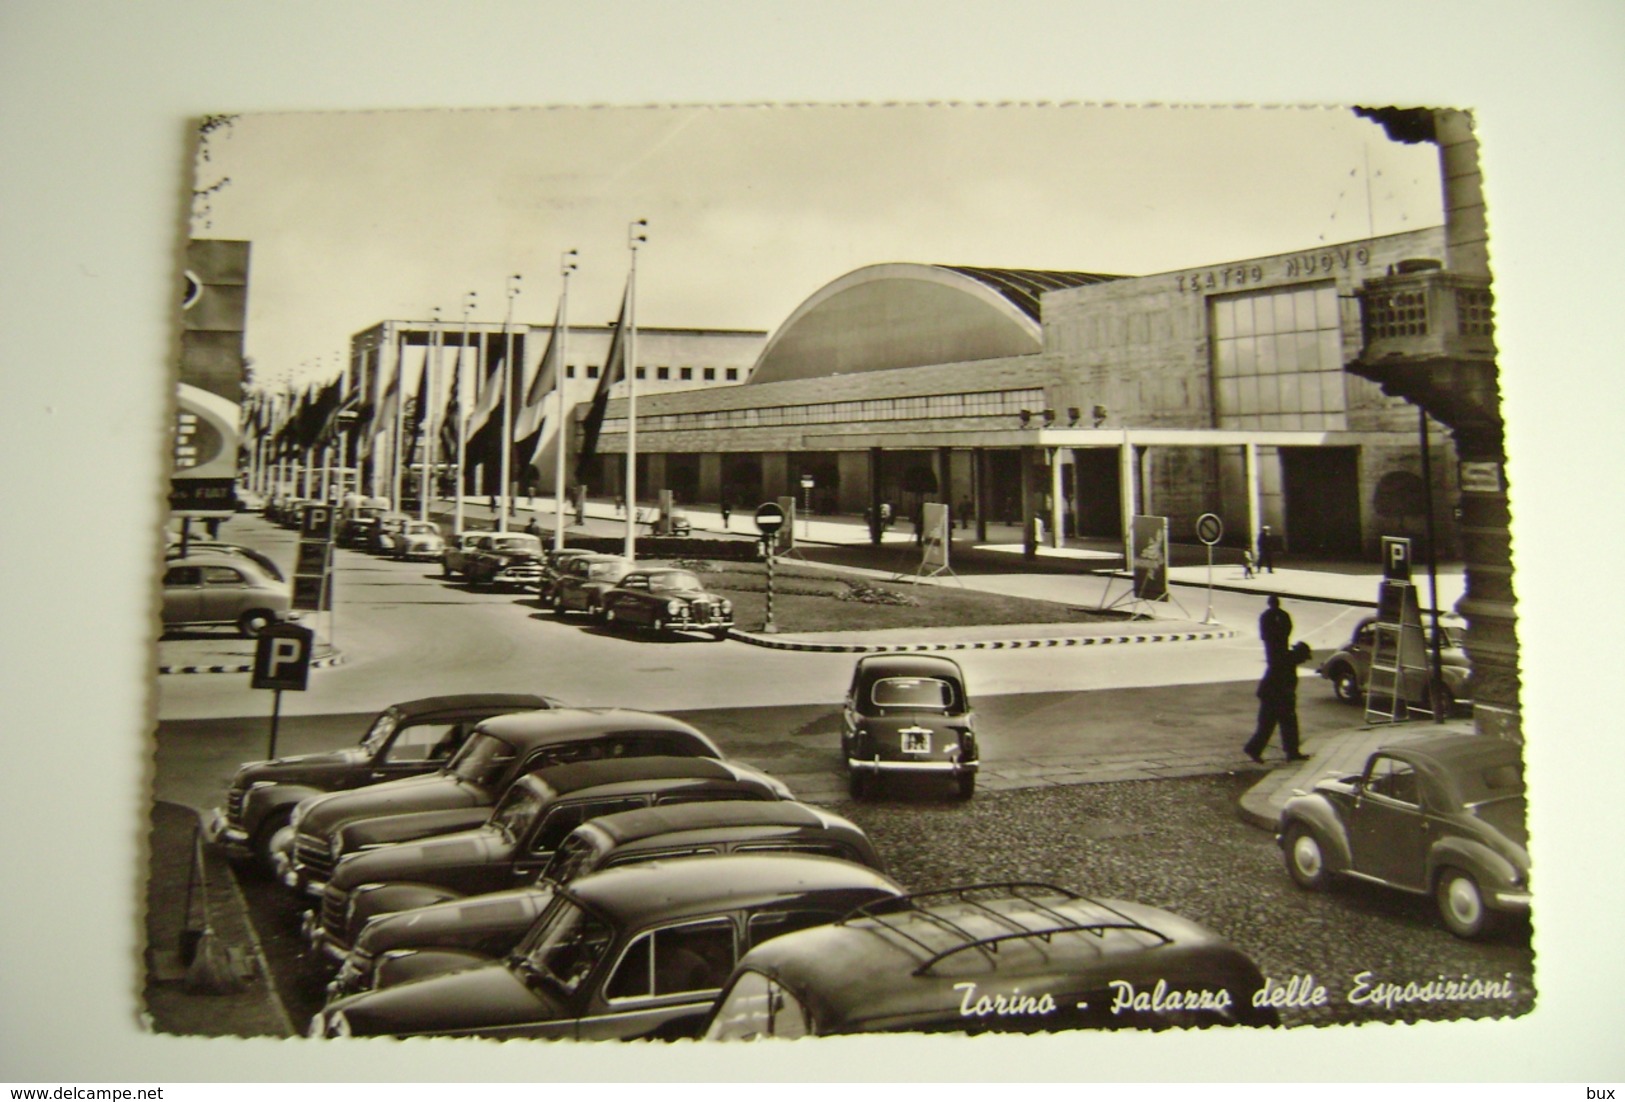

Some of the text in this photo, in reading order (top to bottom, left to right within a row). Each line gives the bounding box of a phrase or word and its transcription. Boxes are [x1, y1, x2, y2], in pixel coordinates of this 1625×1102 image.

[1175, 247, 1370, 292] TEATRO NUOVO
[310, 508, 326, 530] P
[1391, 543, 1404, 569] P
[267, 637, 301, 677] P
[953, 970, 1513, 1016] Torino - Palazzo delle Esposizioni
